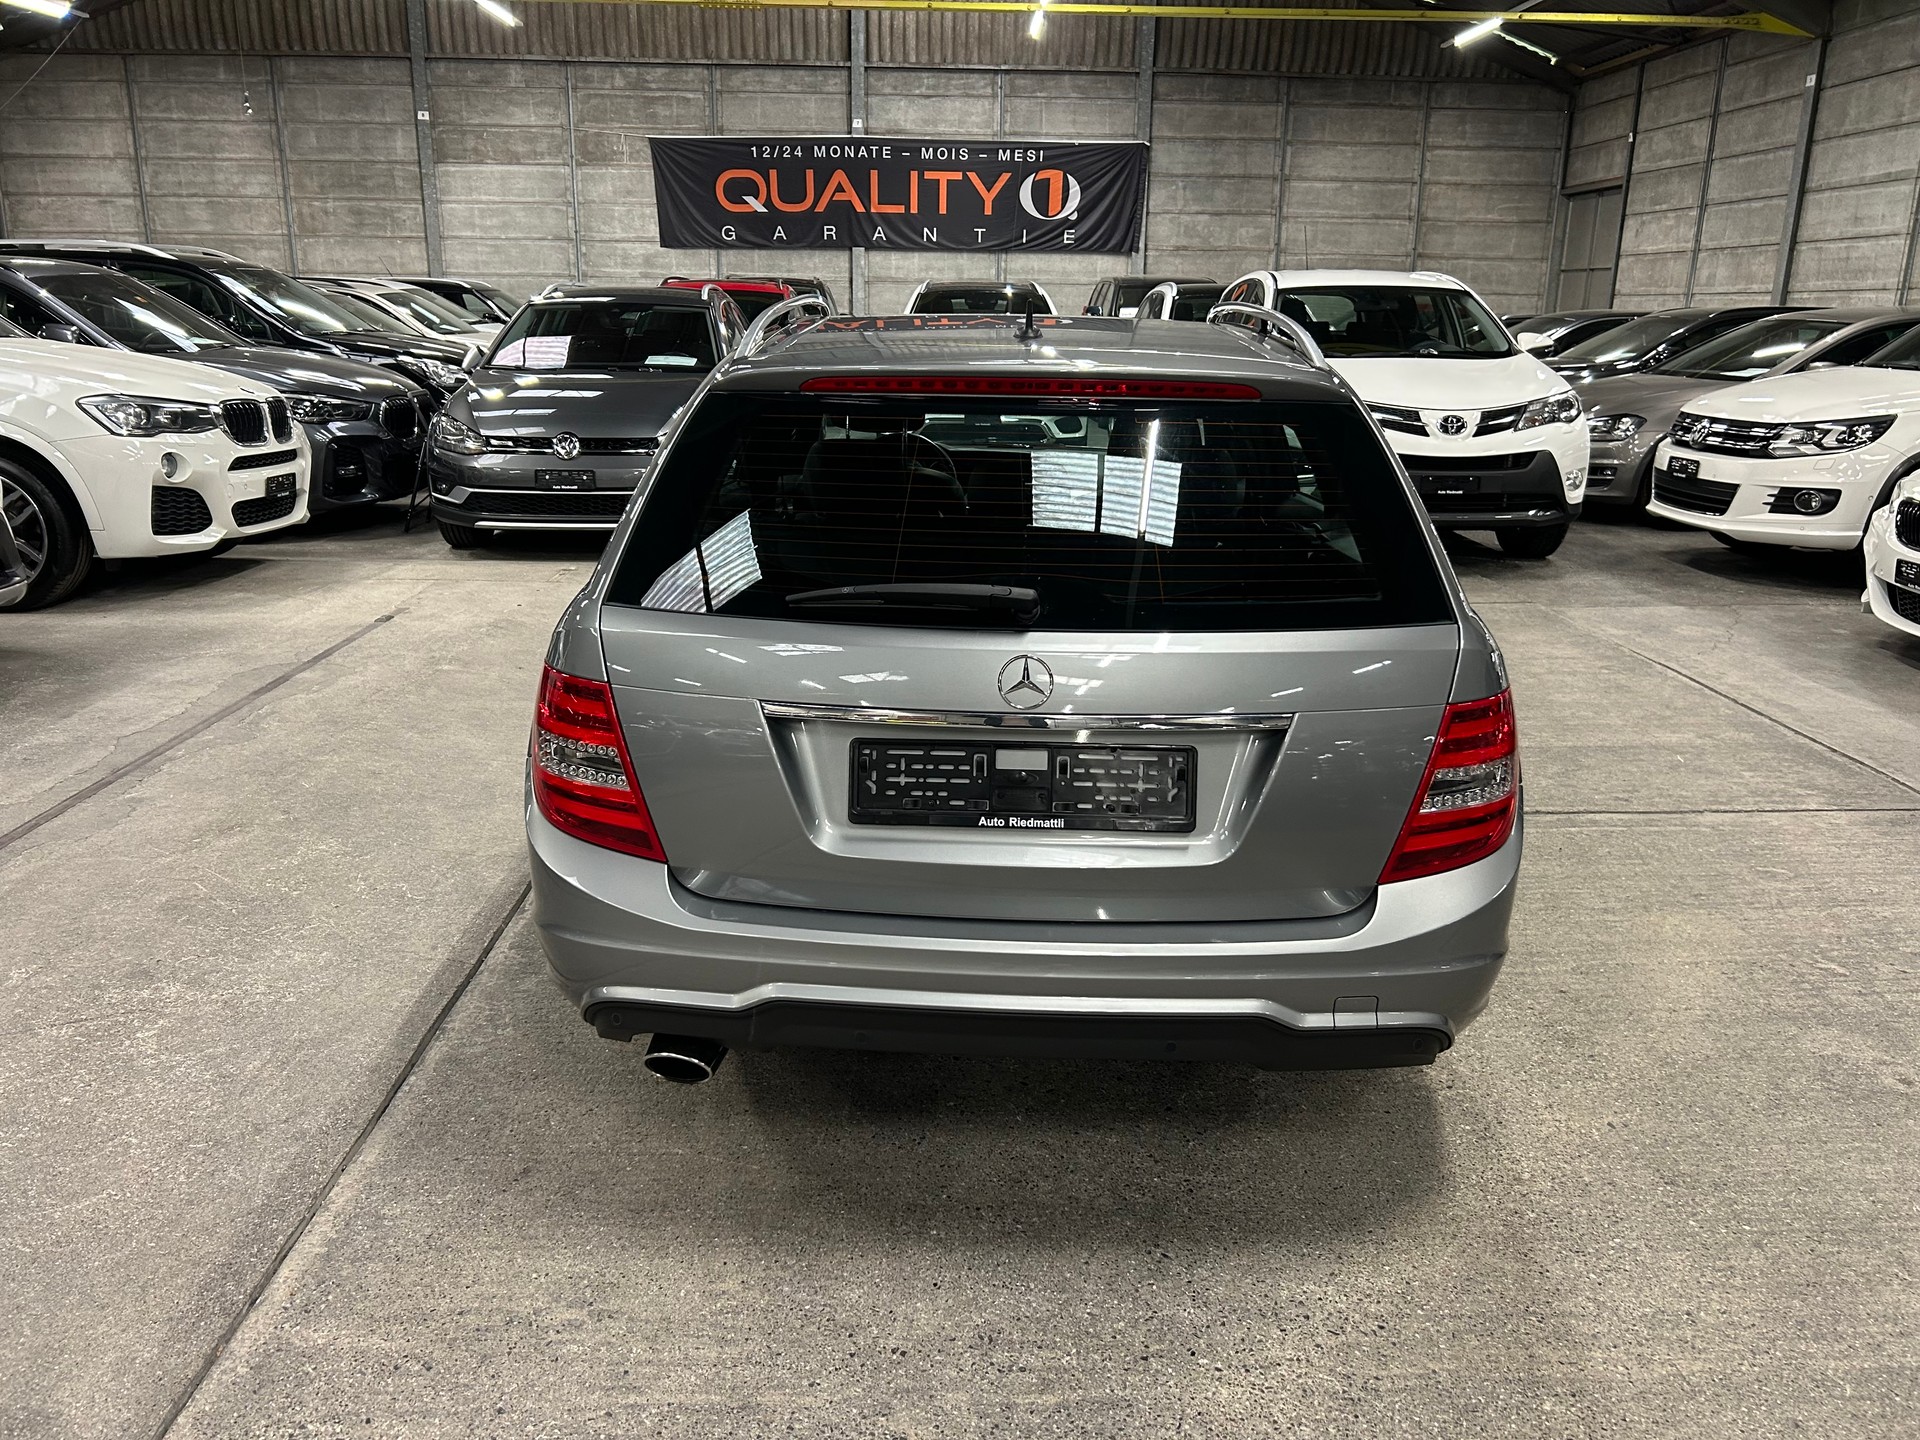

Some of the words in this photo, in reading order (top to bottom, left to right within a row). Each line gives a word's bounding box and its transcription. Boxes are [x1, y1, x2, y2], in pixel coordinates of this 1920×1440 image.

[750, 146, 803, 158] 12/24
[814, 146, 892, 159] MONATE
[921, 148, 969, 160] MOIS
[998, 149, 1044, 162] MESI
[715, 168, 1012, 216] QUALITY
[721, 225, 1076, 244] GARANTIE
[978, 816, 1005, 827] Auto
[1009, 817, 1065, 828] Riedmattli
